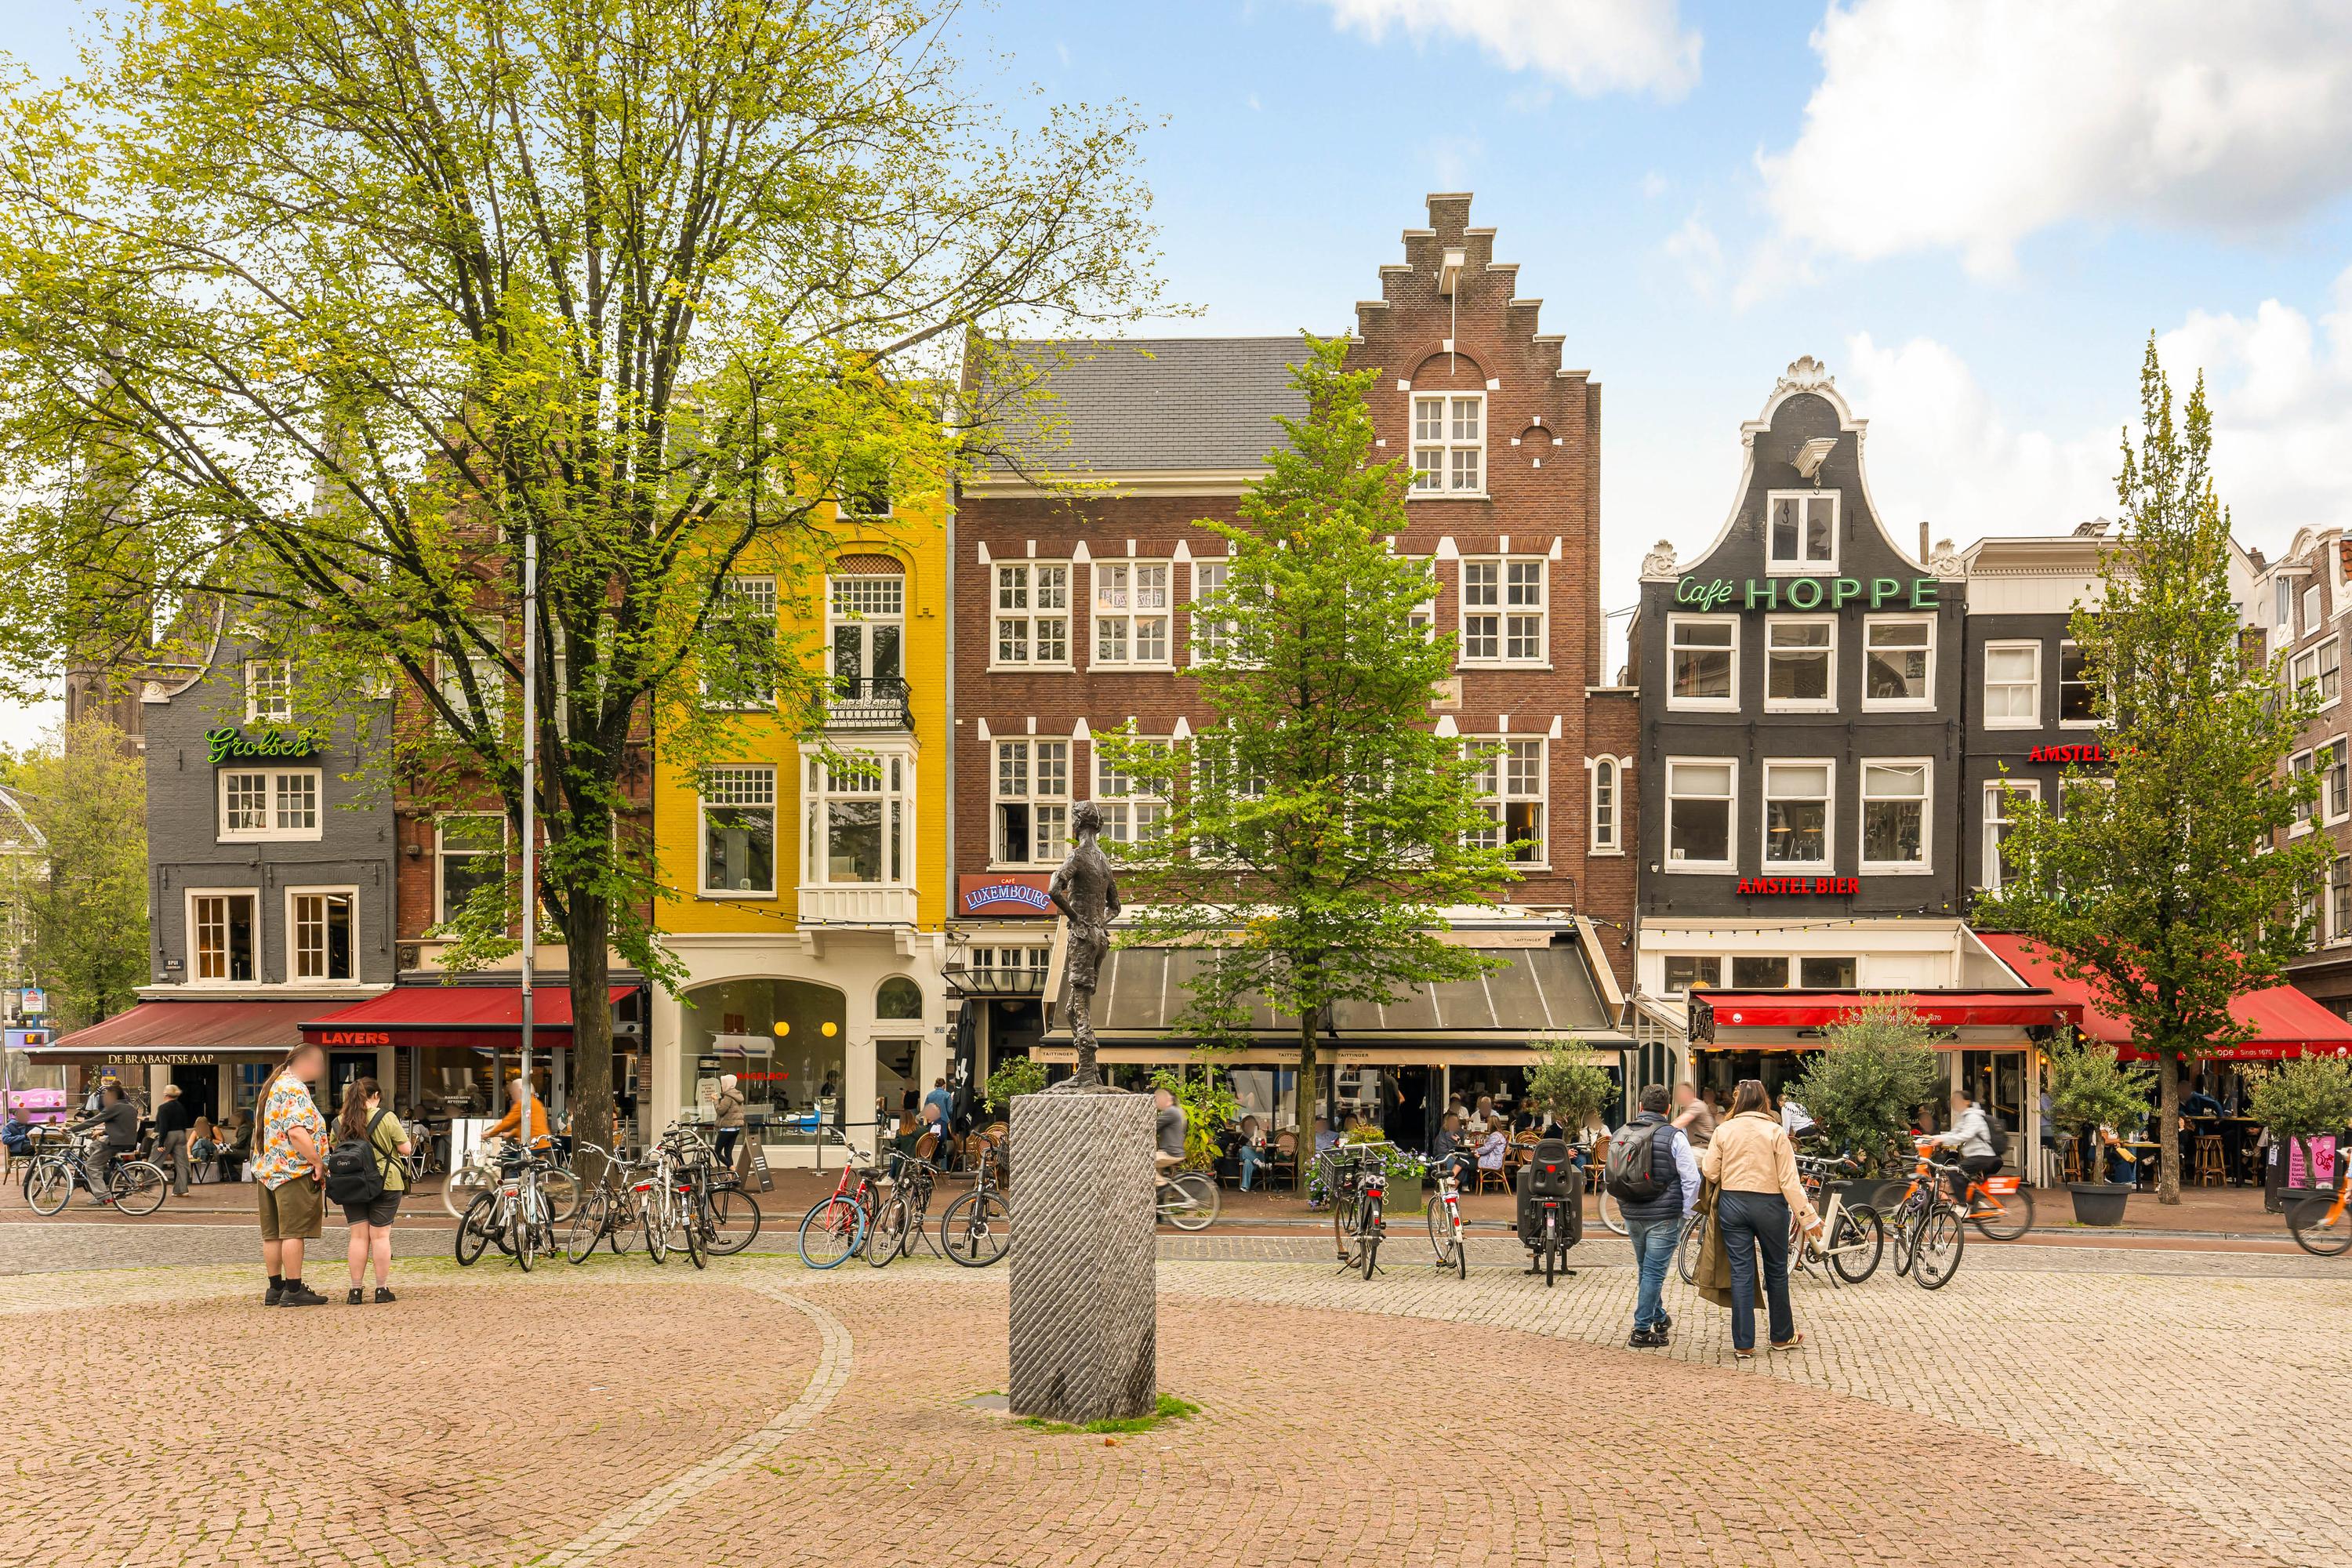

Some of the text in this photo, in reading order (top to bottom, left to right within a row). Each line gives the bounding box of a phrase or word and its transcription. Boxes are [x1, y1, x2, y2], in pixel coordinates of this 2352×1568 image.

[1675, 576, 1940, 613] Café HOPPE
[204, 727, 315, 764] Grolsch
[2028, 746, 2104, 762] AMSTEL
[1736, 877, 1860, 895] AMSTEL BIER
[965, 885, 1051, 908] LUXEMBOURG
[321, 1032, 390, 1044] LAYERS
[108, 1054, 214, 1064] DE BRABANTSE AAP
[737, 1072, 789, 1080] BAGELBOY
